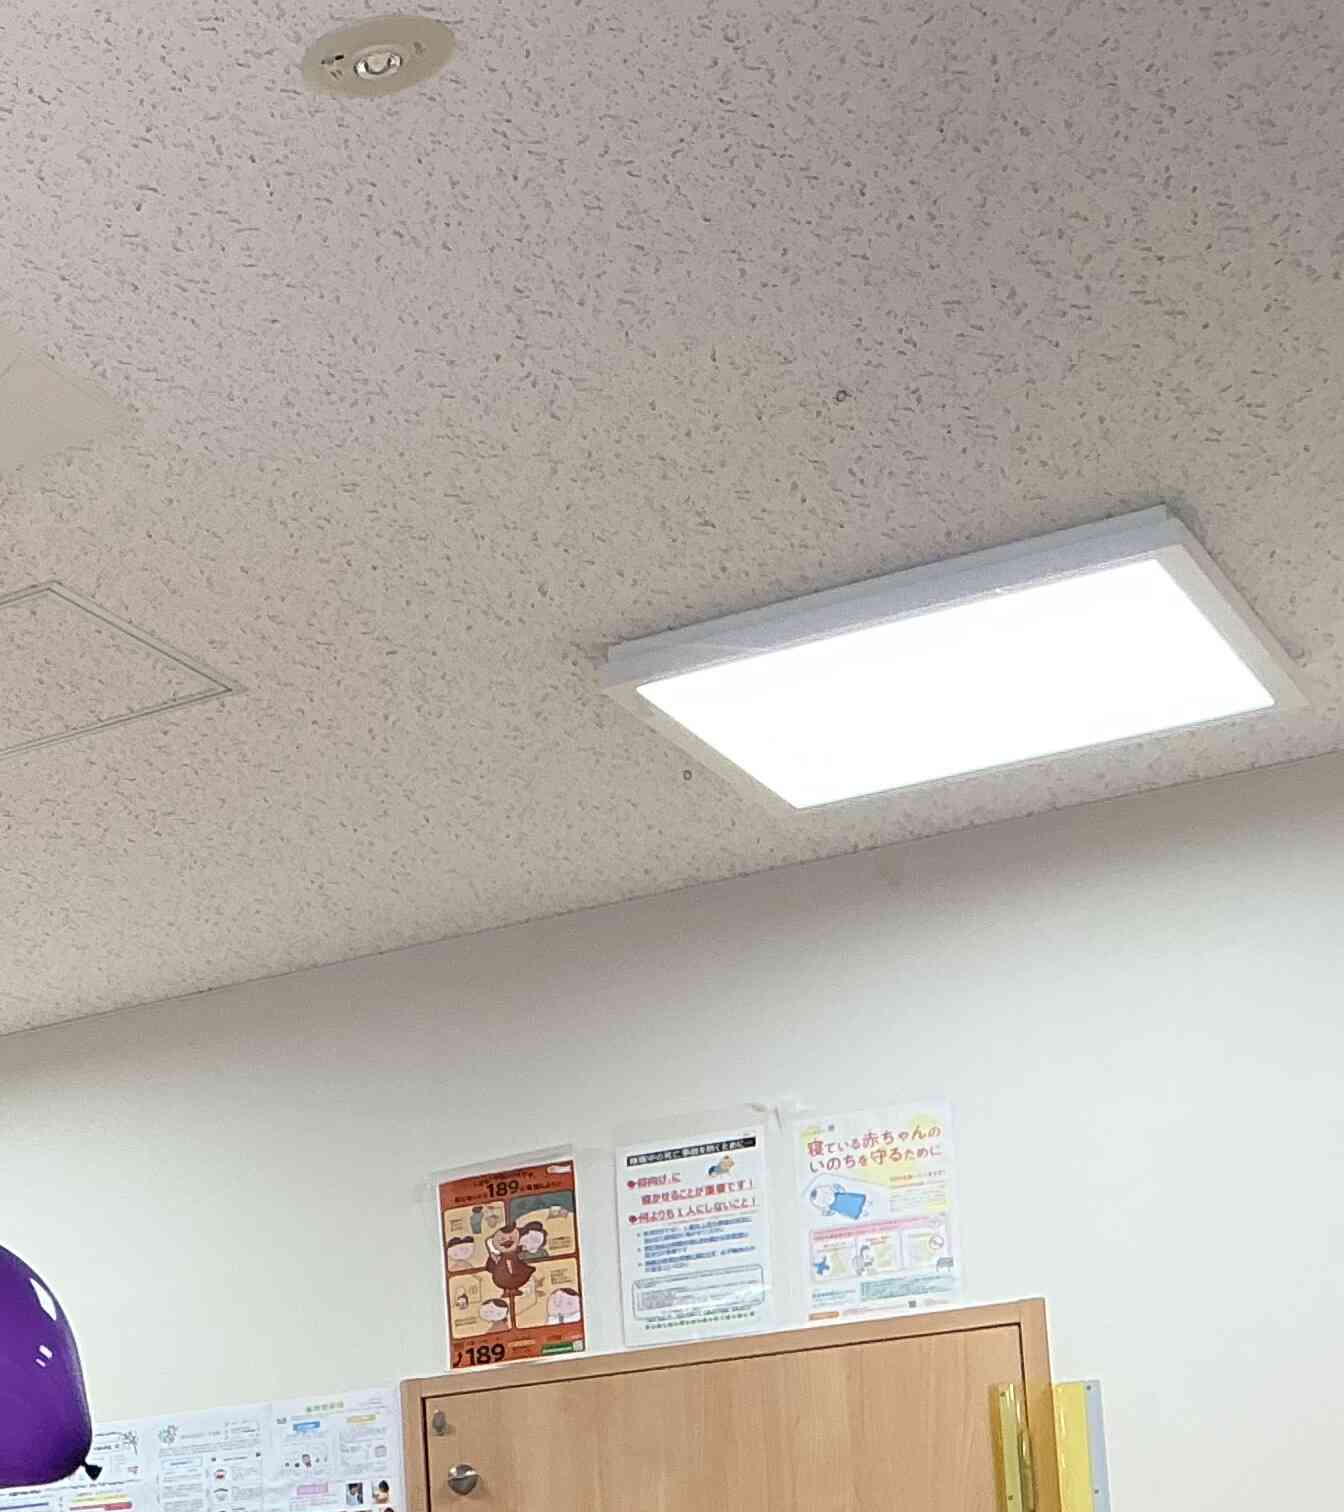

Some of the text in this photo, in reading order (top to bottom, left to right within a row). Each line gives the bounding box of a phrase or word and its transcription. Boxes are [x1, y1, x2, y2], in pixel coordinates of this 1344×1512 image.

[807, 1124, 942, 1157] 寝ている赤ちゃんの
[809, 1144, 943, 1173] いのちを守るために
[486, 1180, 519, 1198] 189
[465, 1343, 505, 1366] 189
